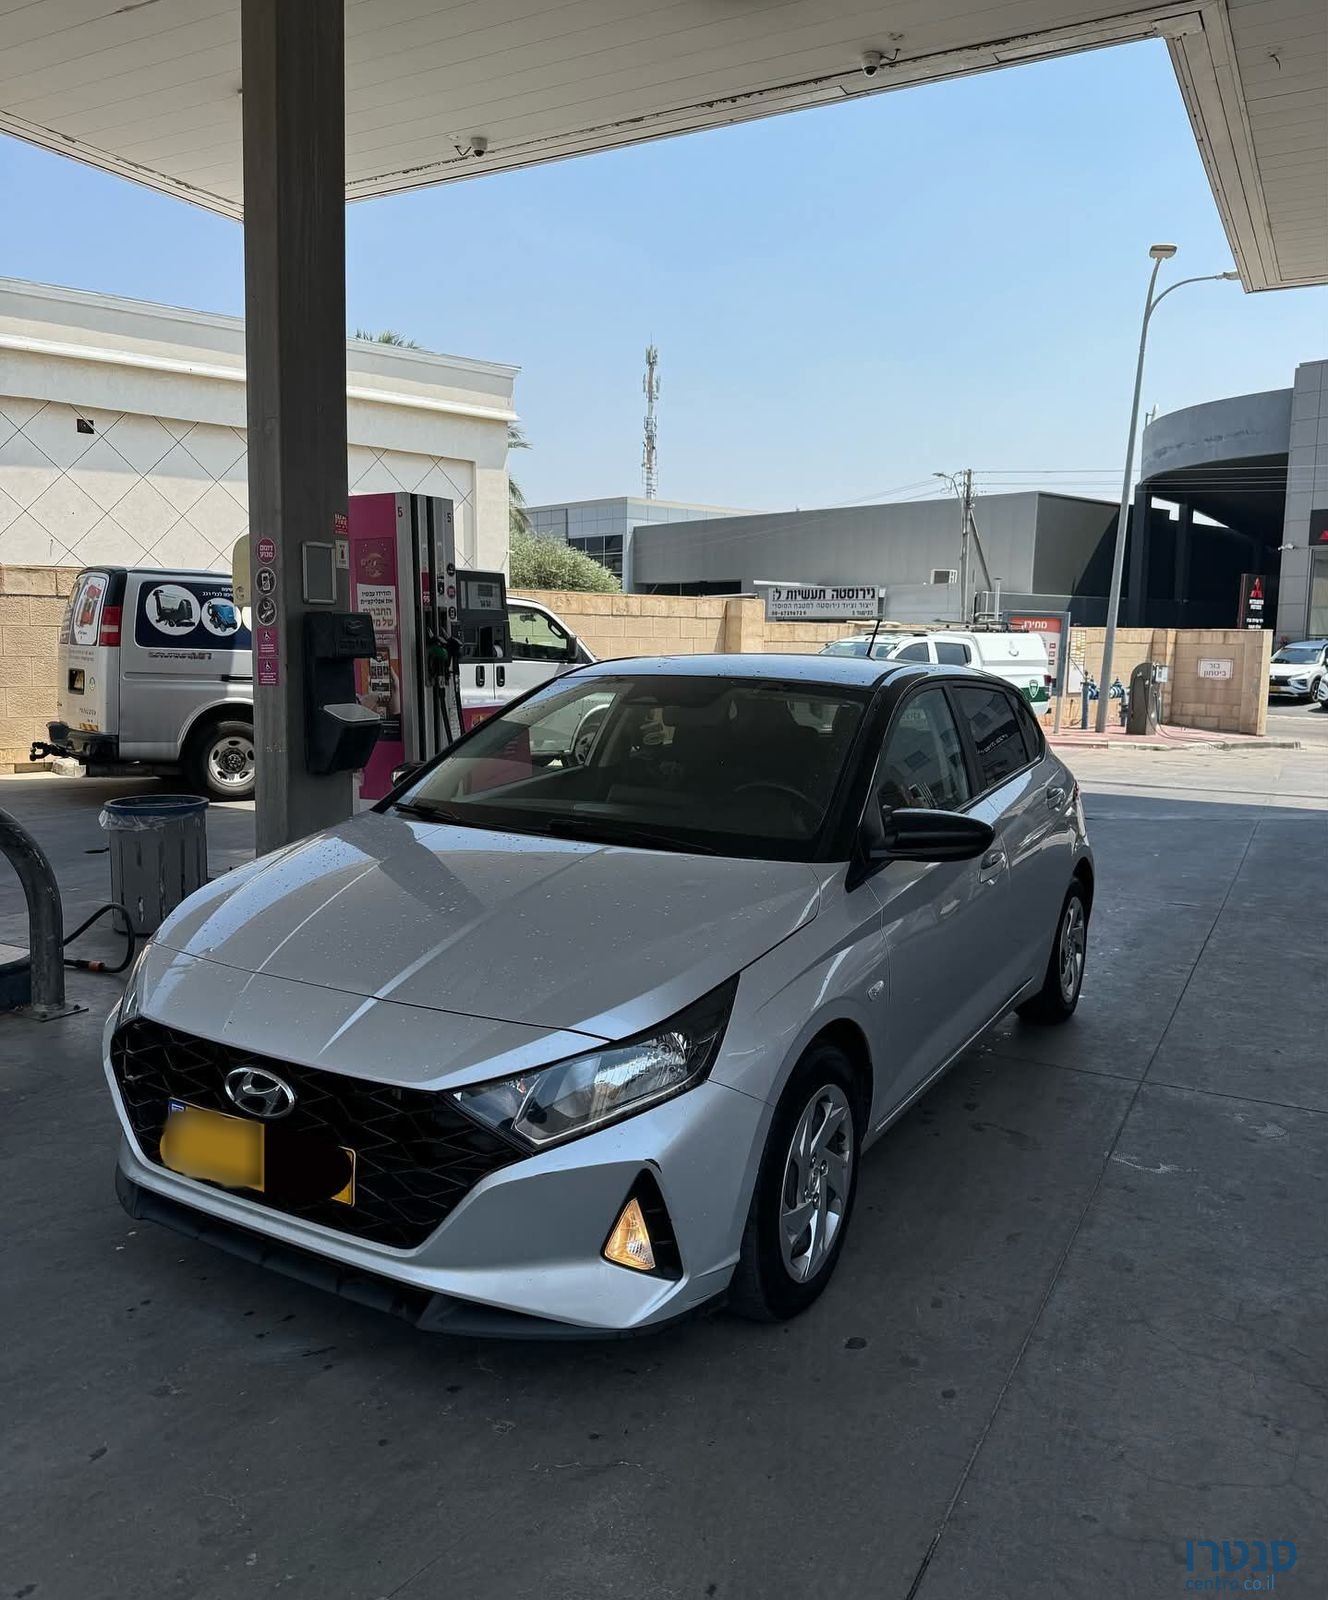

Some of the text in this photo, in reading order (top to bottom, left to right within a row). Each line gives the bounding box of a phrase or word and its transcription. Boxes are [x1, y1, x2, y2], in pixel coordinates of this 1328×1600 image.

[397, 507, 404, 518] 5
[786, 588, 826, 600] תעשיות
[831, 588, 876, 600] נירוסטה
